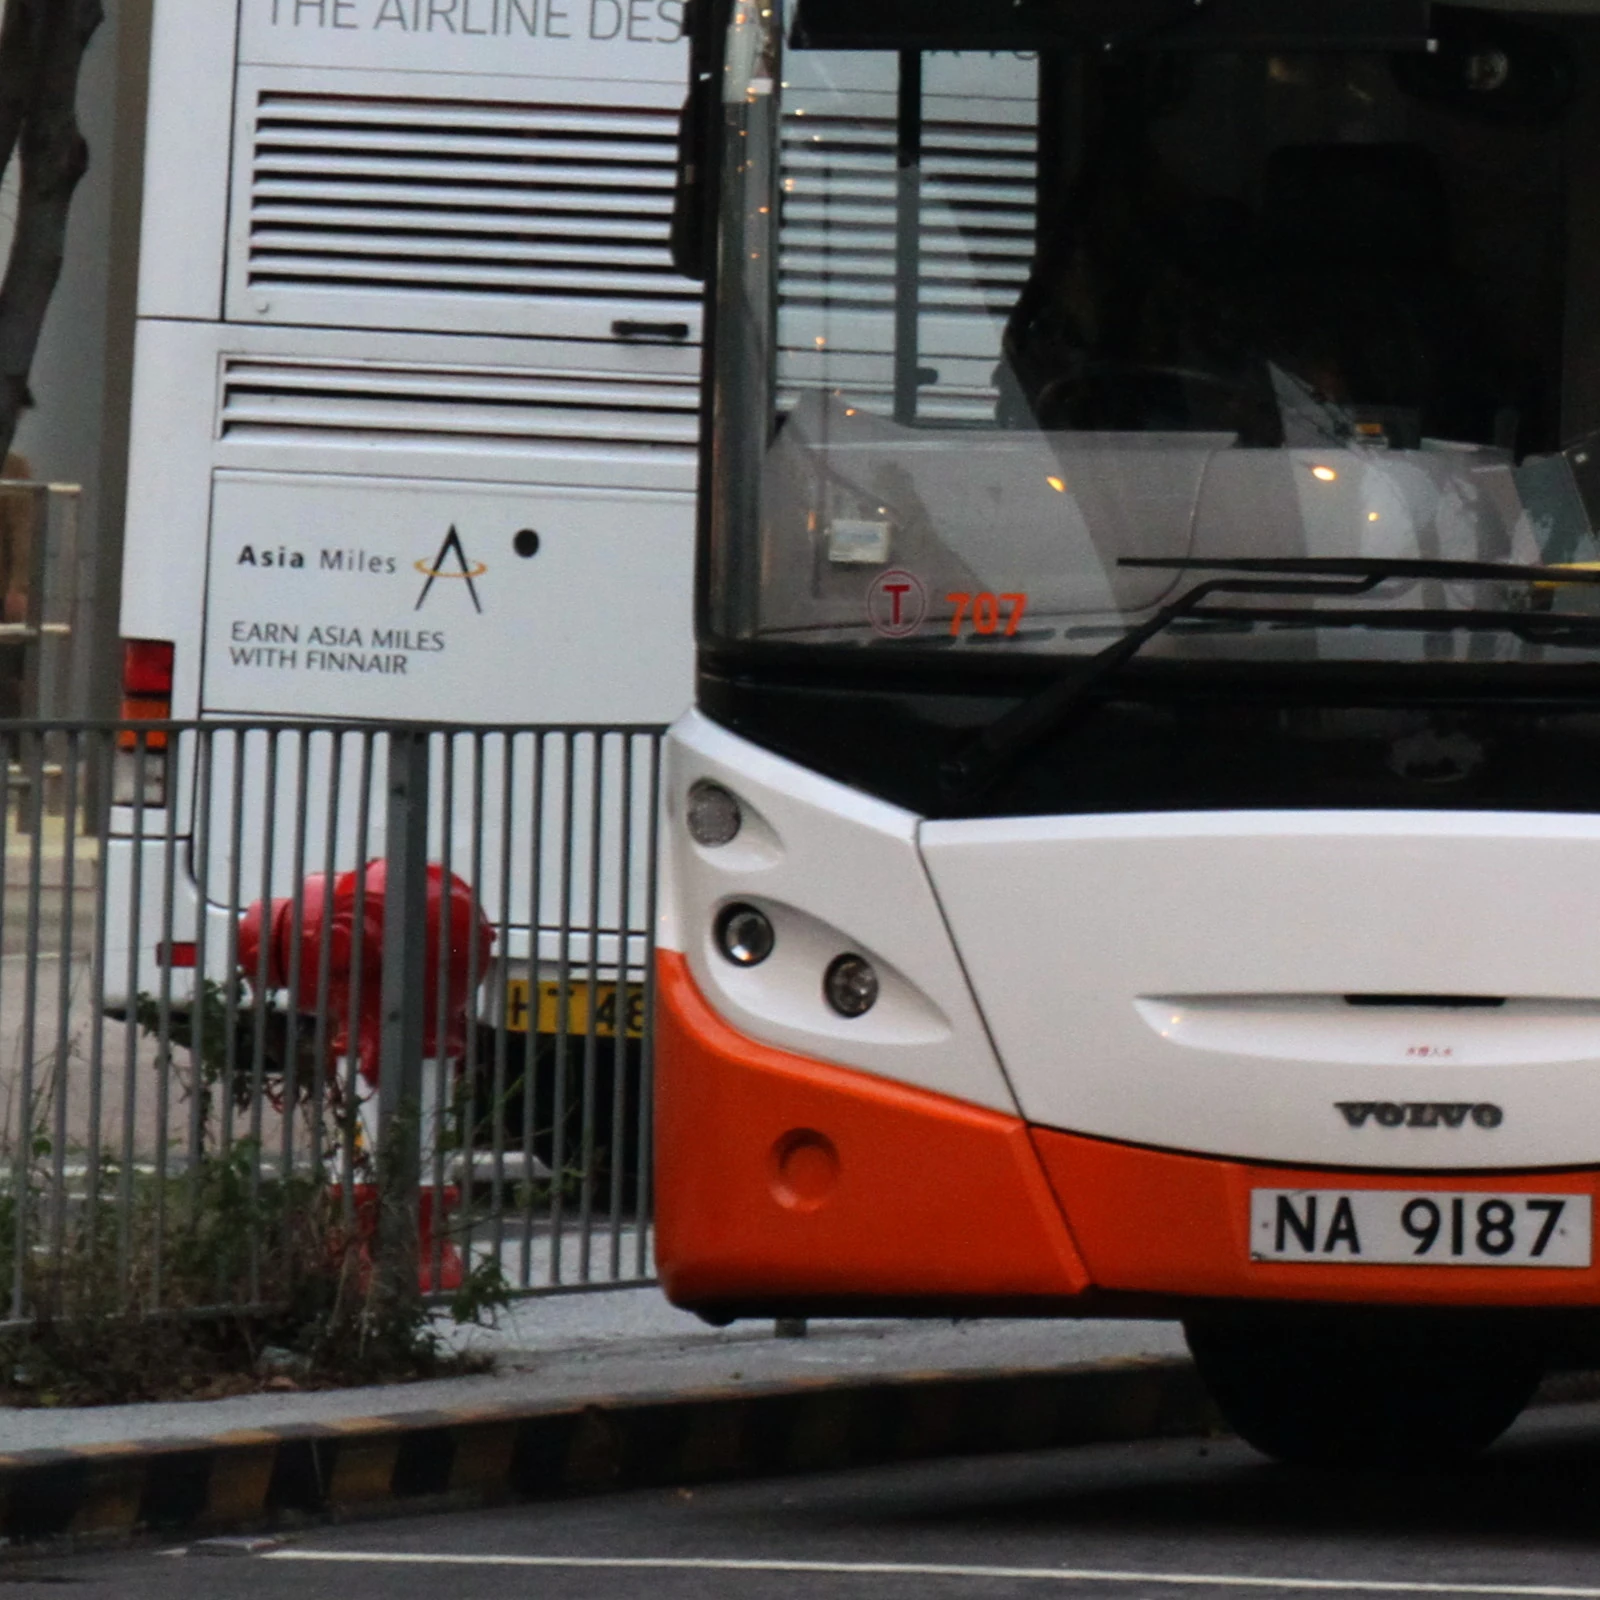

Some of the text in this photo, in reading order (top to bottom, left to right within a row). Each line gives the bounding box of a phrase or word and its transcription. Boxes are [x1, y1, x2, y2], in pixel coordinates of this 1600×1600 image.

[237, 545, 397, 574] Asia Miles
[882, 584, 910, 625] T
[945, 591, 1028, 637] 707
[231, 620, 445, 652] EARN ASIA MILES
[229, 646, 408, 675] WITH FINNAIR
[1334, 1100, 1504, 1130] VOLVO
[1273, 1195, 1567, 1257] NA 9187
